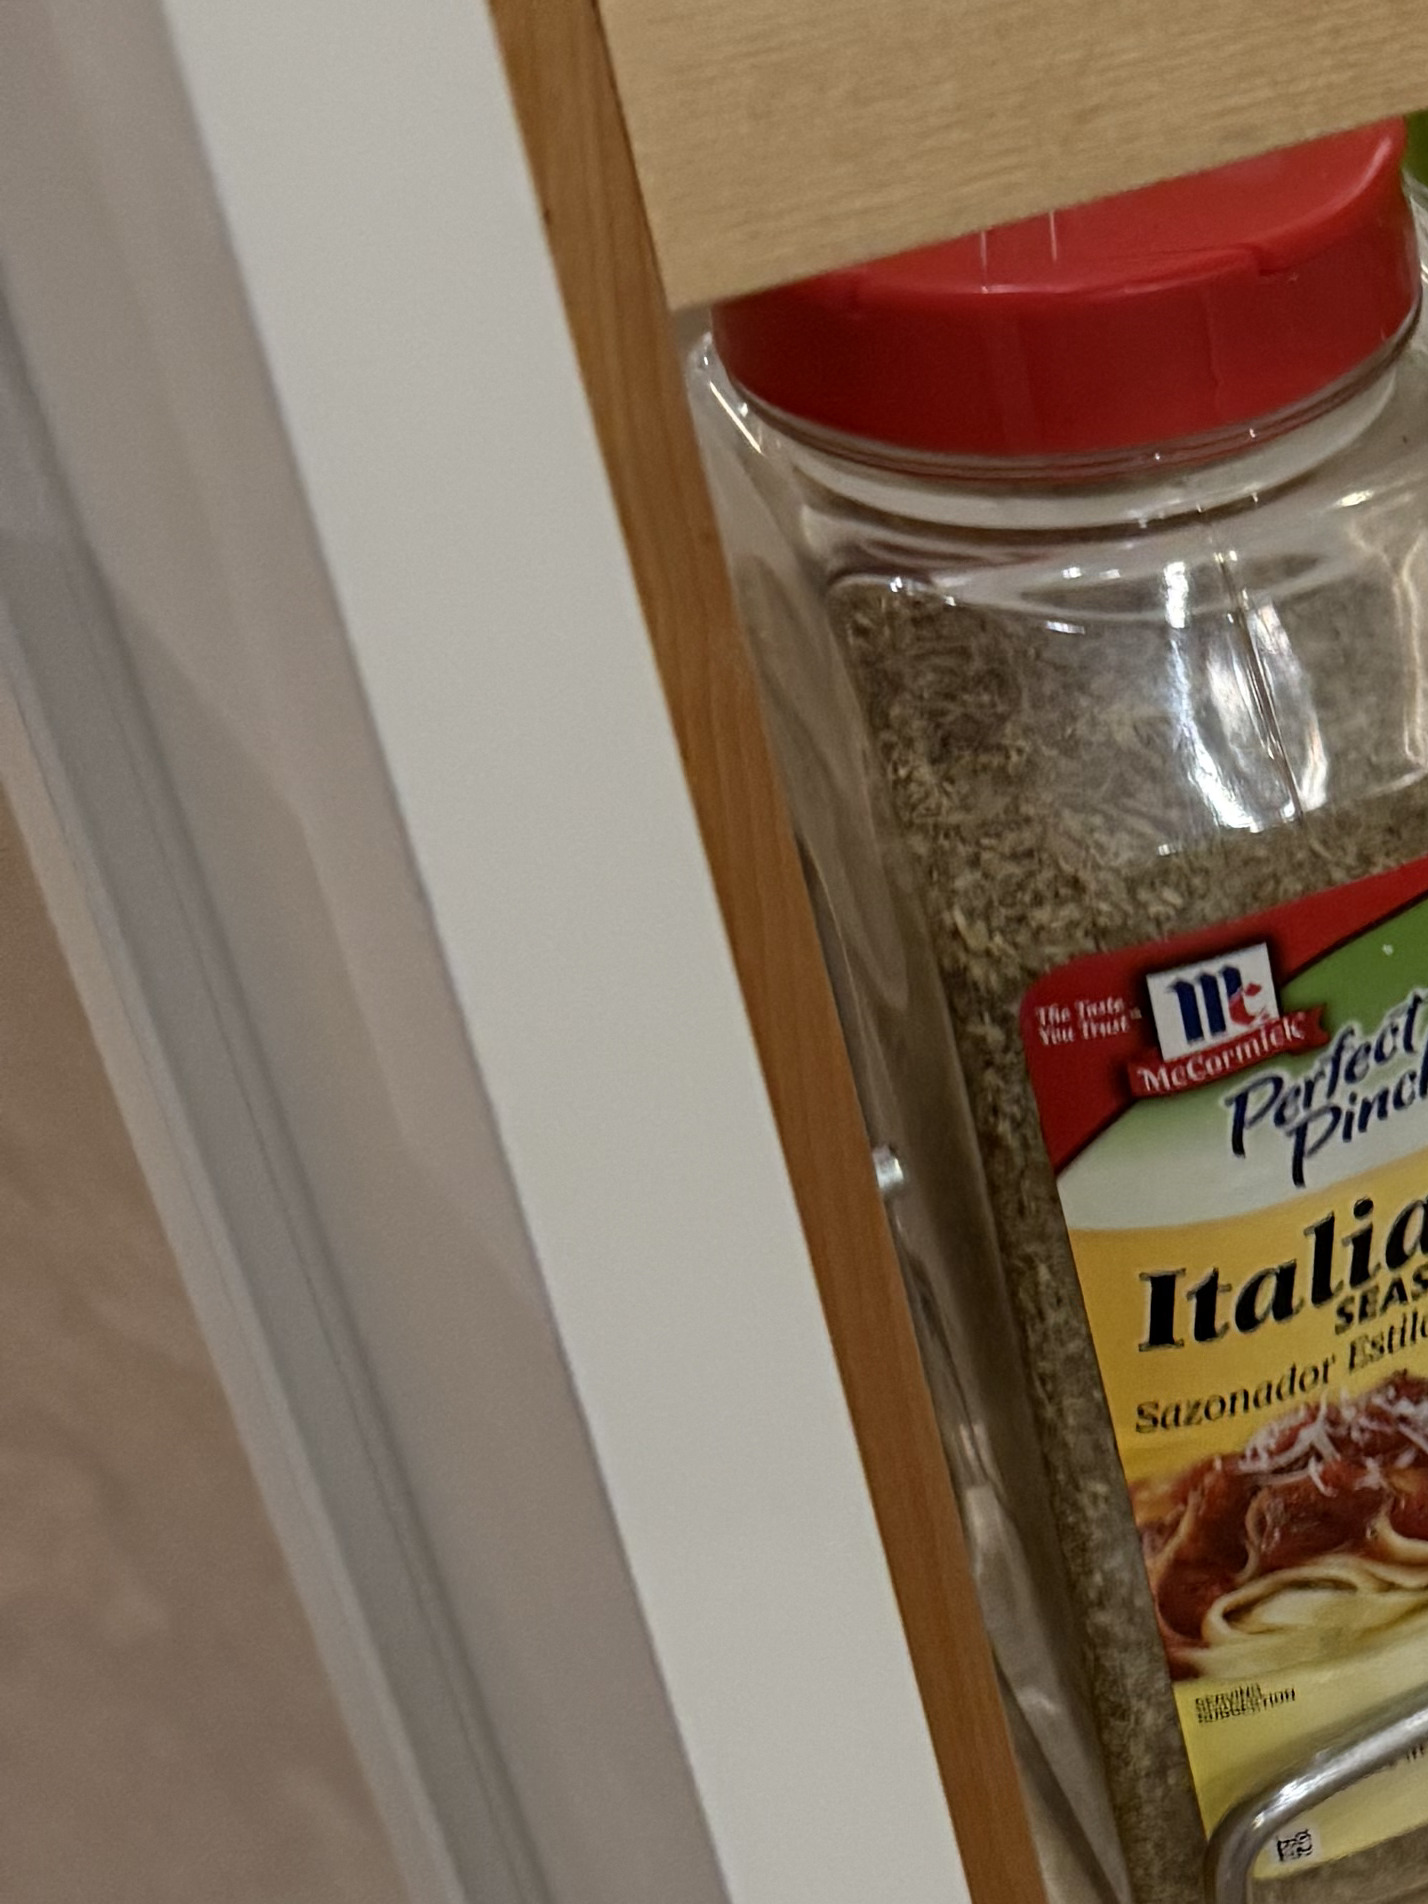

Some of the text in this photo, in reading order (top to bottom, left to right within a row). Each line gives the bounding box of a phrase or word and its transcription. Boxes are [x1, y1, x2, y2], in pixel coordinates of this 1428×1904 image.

[1034, 1002, 1071, 1029] The
[1136, 1010, 1306, 1093] McCormick
[1135, 1348, 1337, 1435] Sazonador
